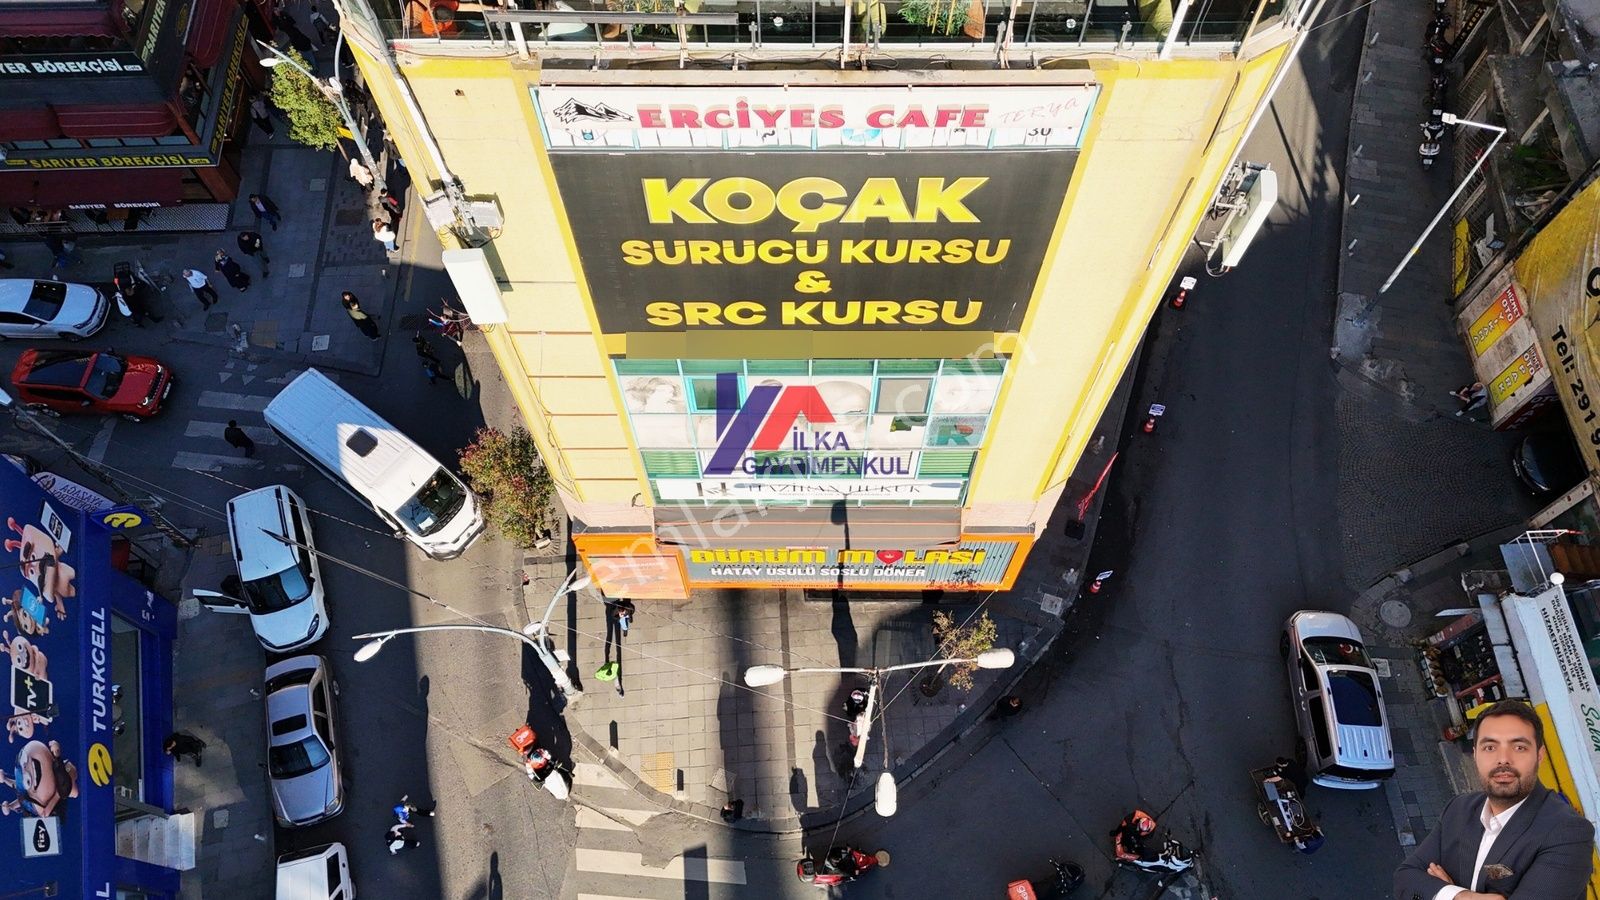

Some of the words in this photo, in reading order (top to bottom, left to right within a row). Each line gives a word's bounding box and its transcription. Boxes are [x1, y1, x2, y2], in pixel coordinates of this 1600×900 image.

[31, 58, 124, 74] BÖREKÇİSİ
[637, 96, 845, 129] ERCİYES
[865, 103, 990, 128] CAFE
[30, 156, 99, 169] SARIYER
[101, 153, 187, 167] BÖREKÇİSİ
[643, 177, 990, 233] KOÇAK
[840, 238, 1011, 264] KURSU
[794, 269, 833, 294] &
[645, 300, 767, 327] SRC
[781, 299, 983, 326] KURSU
[1501, 299, 1513, 322] OTO
[1523, 353, 1535, 376] OTO
[1551, 324, 1575, 374] Tel:
[1570, 378, 1596, 424] 291
[711, 567, 762, 576] HATAY
[873, 565, 926, 577] DÖNER
[88, 606, 107, 732] TURKCELL
[37, 825, 46, 849] fizy
